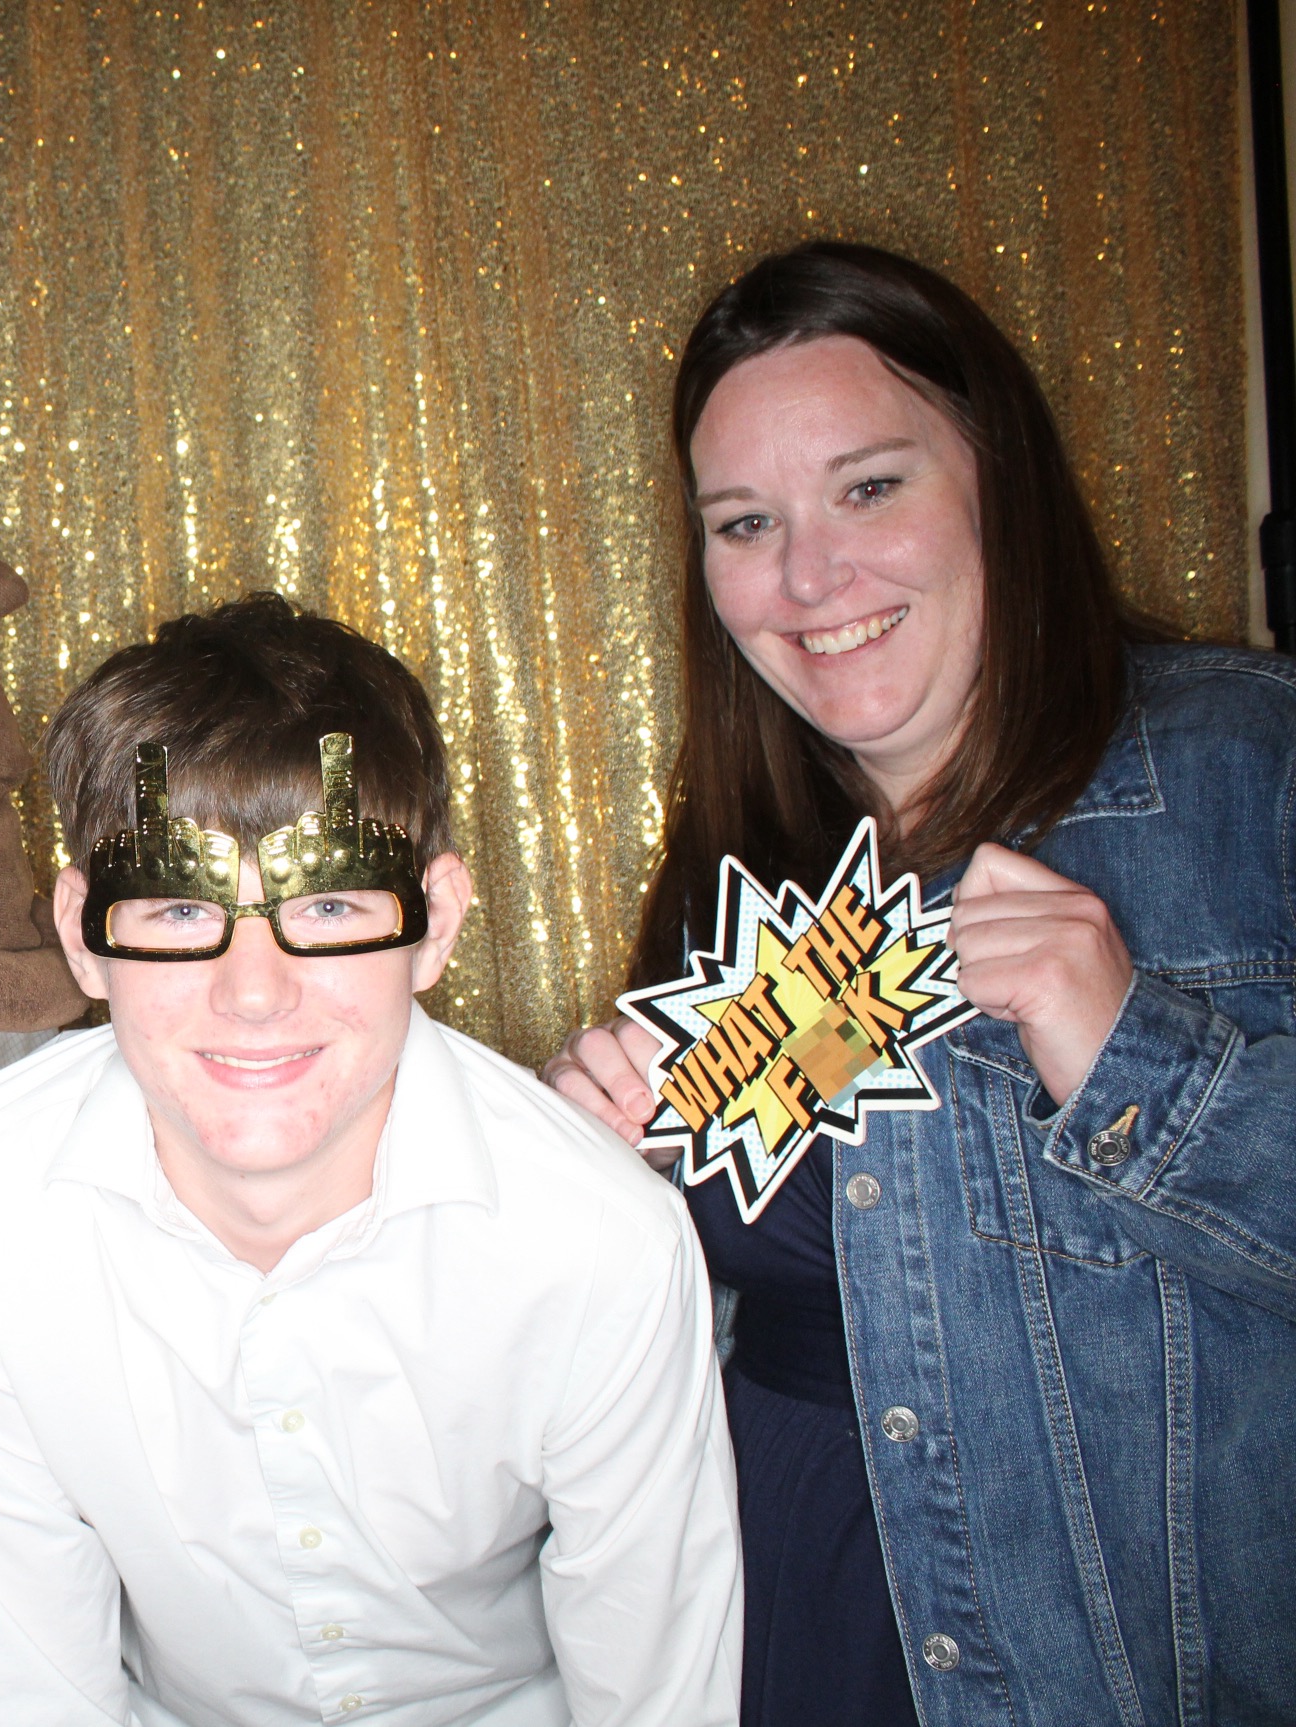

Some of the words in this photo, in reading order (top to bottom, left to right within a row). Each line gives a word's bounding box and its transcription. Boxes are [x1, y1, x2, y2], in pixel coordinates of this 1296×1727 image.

[658, 972, 789, 1134] WHAT
[781, 884, 883, 1000] THE
[764, 970, 906, 1132] FK
